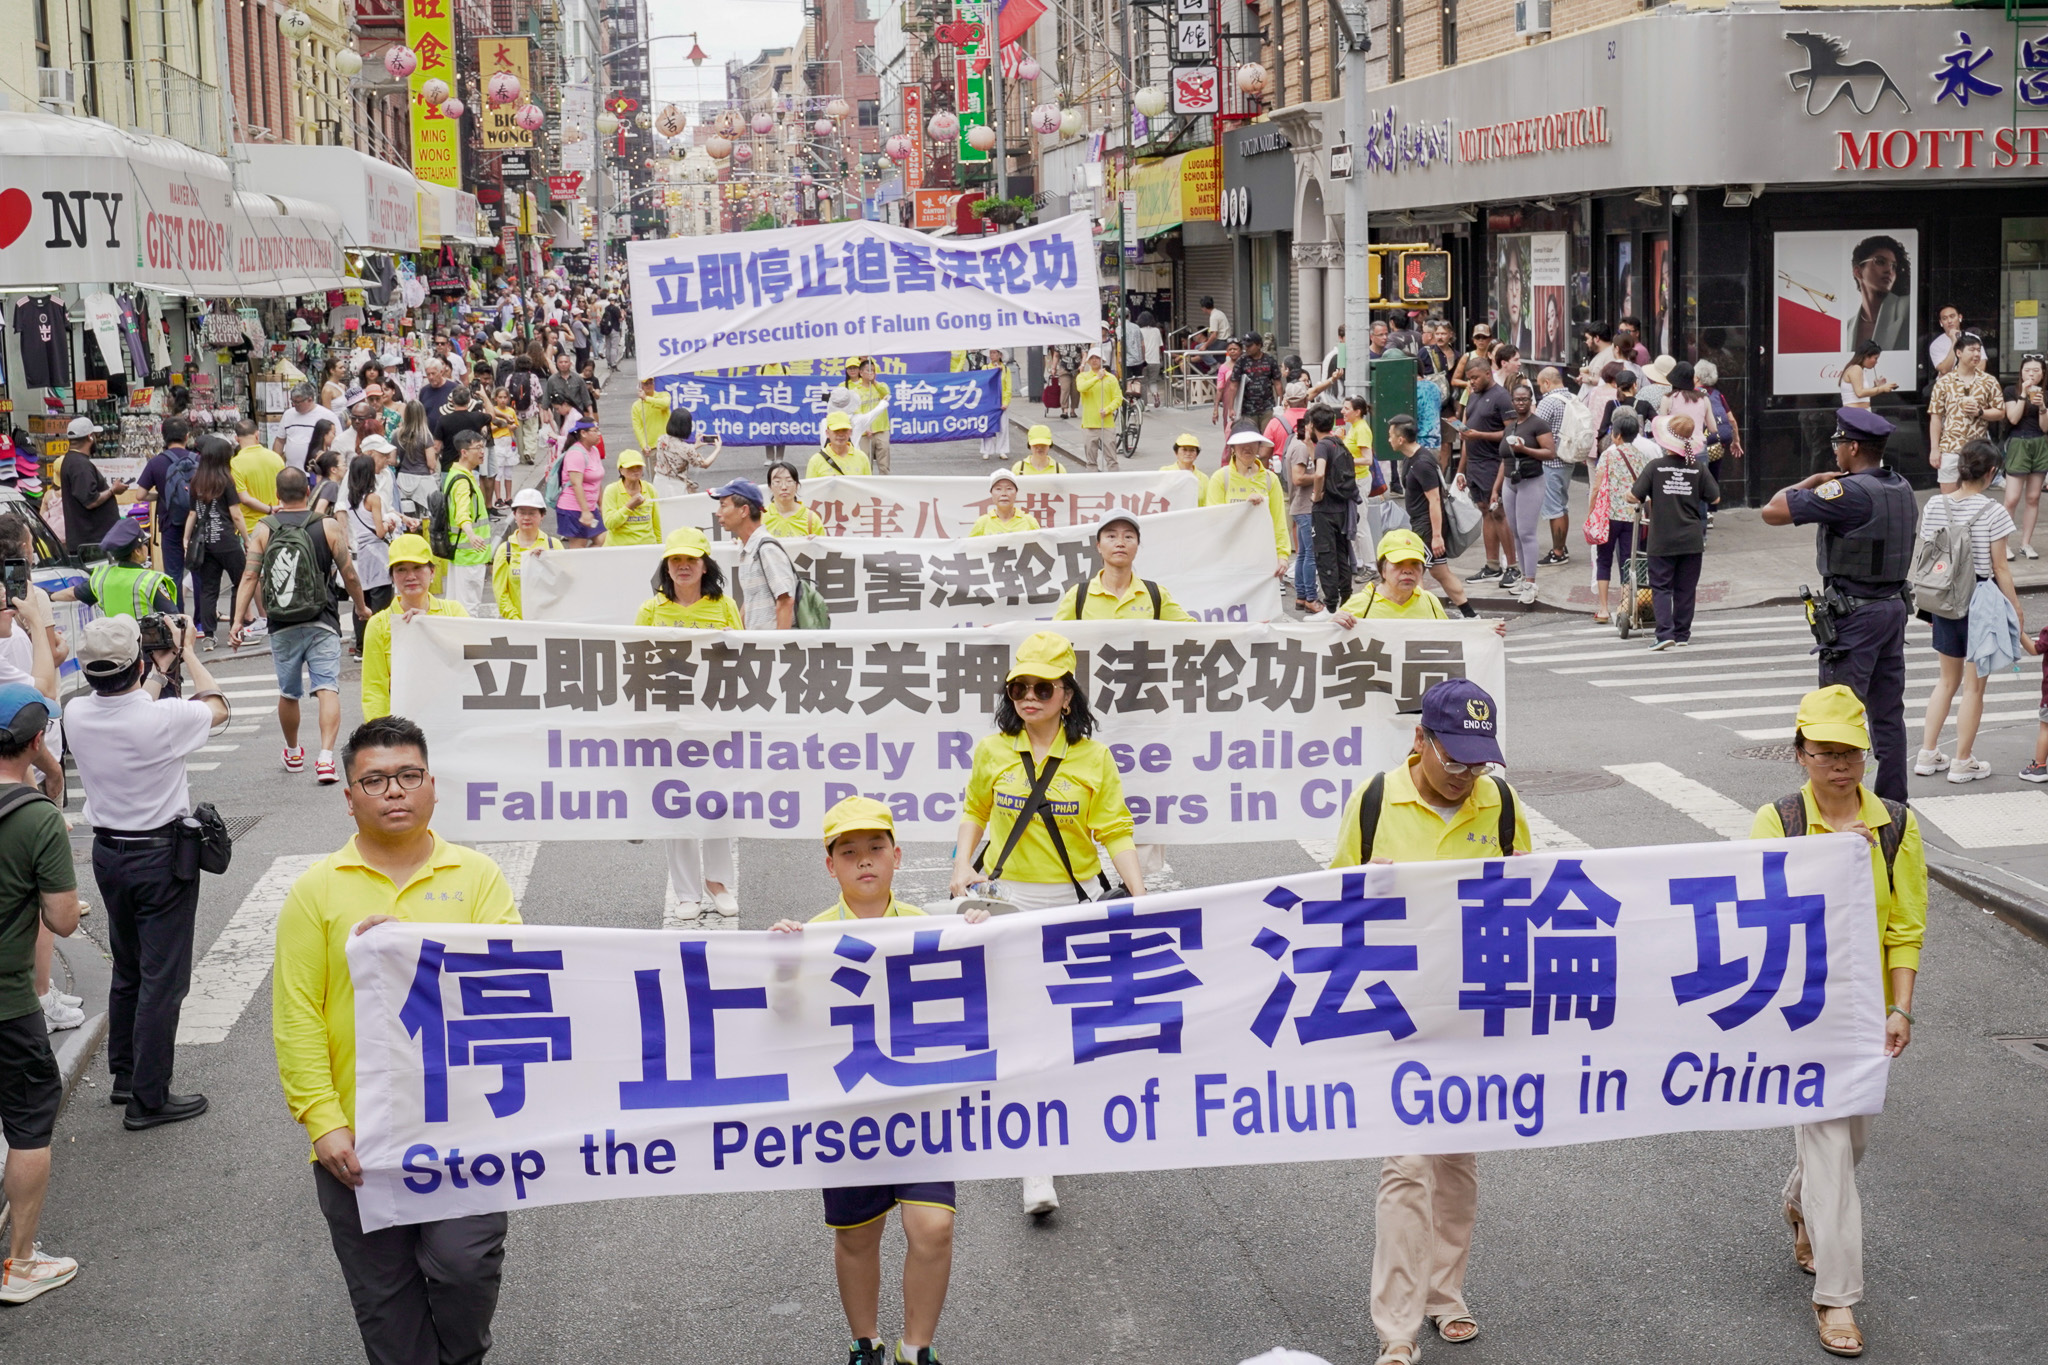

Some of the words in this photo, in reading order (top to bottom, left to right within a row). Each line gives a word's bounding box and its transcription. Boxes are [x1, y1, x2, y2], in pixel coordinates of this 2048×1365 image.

[1608, 41, 1616, 60] 52
[421, 130, 447, 142] MING
[487, 131, 529, 143] WONG
[1041, 112, 1056, 131] 春
[1458, 125, 1494, 163] MOTT
[1494, 116, 1543, 158] STREET
[1543, 106, 1608, 151] OPTICAL
[419, 148, 450, 162] WONG
[1836, 129, 1984, 171] MOTT
[415, 166, 457, 180] RESTAURANT
[1184, 172, 1208, 182] SCHOOL
[1198, 194, 1215, 204] HATS
[42, 191, 123, 248] NY
[146, 211, 184, 270] GIFT
[188, 217, 225, 272] SHOP
[239, 237, 256, 273] ALL
[258, 236, 283, 271] KINDS
[284, 237, 294, 269] OF
[649, 233, 1079, 316] 立即停止迫害法轮功
[658, 335, 708, 358] Stop
[713, 319, 839, 349] Persecution
[844, 316, 867, 335] of
[872, 310, 931, 335] Falun
[937, 308, 993, 332] Gong
[999, 307, 1019, 327] in
[1022, 307, 1082, 328] China
[665, 379, 984, 414] 停止迫害輪功
[713, 417, 743, 435] the
[749, 420, 821, 440] persecu
[890, 417, 940, 436] Falun
[943, 415, 989, 434] Gong
[463, 636, 1467, 715] 立即释放被关押法轮功学员
[1463, 719, 1480, 730] END
[547, 728, 916, 781] Immediately
[1197, 726, 1364, 773] Jailed
[467, 781, 629, 822] Falun
[651, 778, 801, 830] Gong
[1229, 781, 1280, 823] in
[400, 851, 1827, 1125] 停止迫害法輪功
[403, 1145, 546, 1201] Stop
[581, 1131, 676, 1176] the
[711, 1087, 1069, 1171] Persecution
[1105, 1079, 1160, 1143] of
[1196, 1072, 1357, 1137] Falun
[1393, 1062, 1545, 1138] Gong
[1581, 1057, 1628, 1115] in
[1663, 1053, 1826, 1108] China
